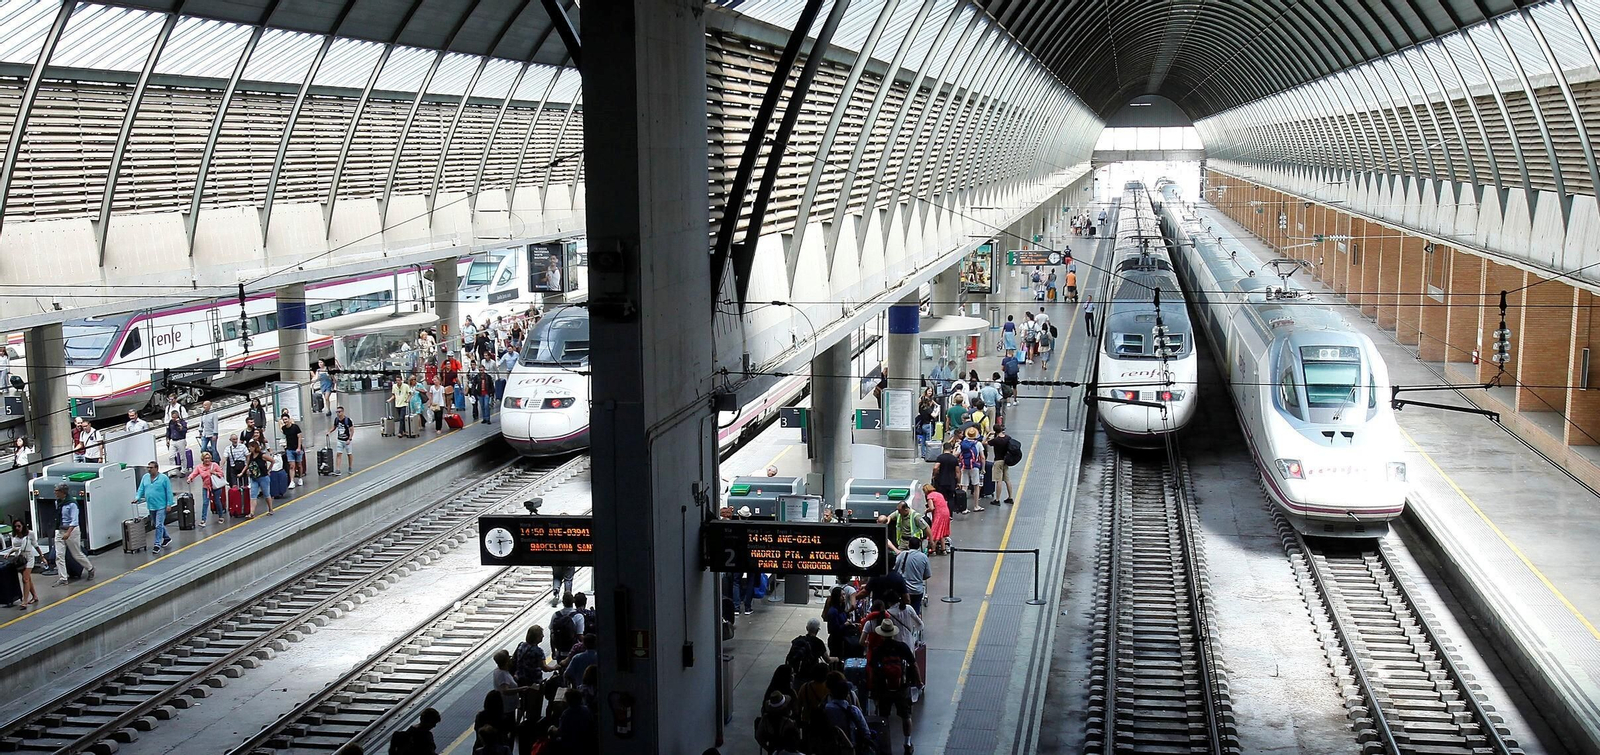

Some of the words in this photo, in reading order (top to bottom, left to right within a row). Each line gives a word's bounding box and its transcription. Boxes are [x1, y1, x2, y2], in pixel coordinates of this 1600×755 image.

[152, 326, 182, 350] renfe
[518, 376, 562, 385] renfe
[6, 405, 12, 414] 5
[86, 407, 93, 416] 4
[781, 418, 788, 427] 3
[874, 419, 880, 429] 2
[520, 528, 544, 536] 14:50
[748, 534, 774, 543] 14:45
[777, 535, 822, 544] AVE-02141
[530, 543, 573, 552] BARCELONA
[576, 544, 593, 552] SAN
[725, 549, 736, 567] 2
[750, 550, 781, 558] MADRID
[785, 550, 804, 559] PTA.
[810, 551, 840, 560] ATOCHA
[758, 560, 778, 568] PARA
[782, 560, 793, 569] EN
[797, 561, 832, 570] CORDOBA
